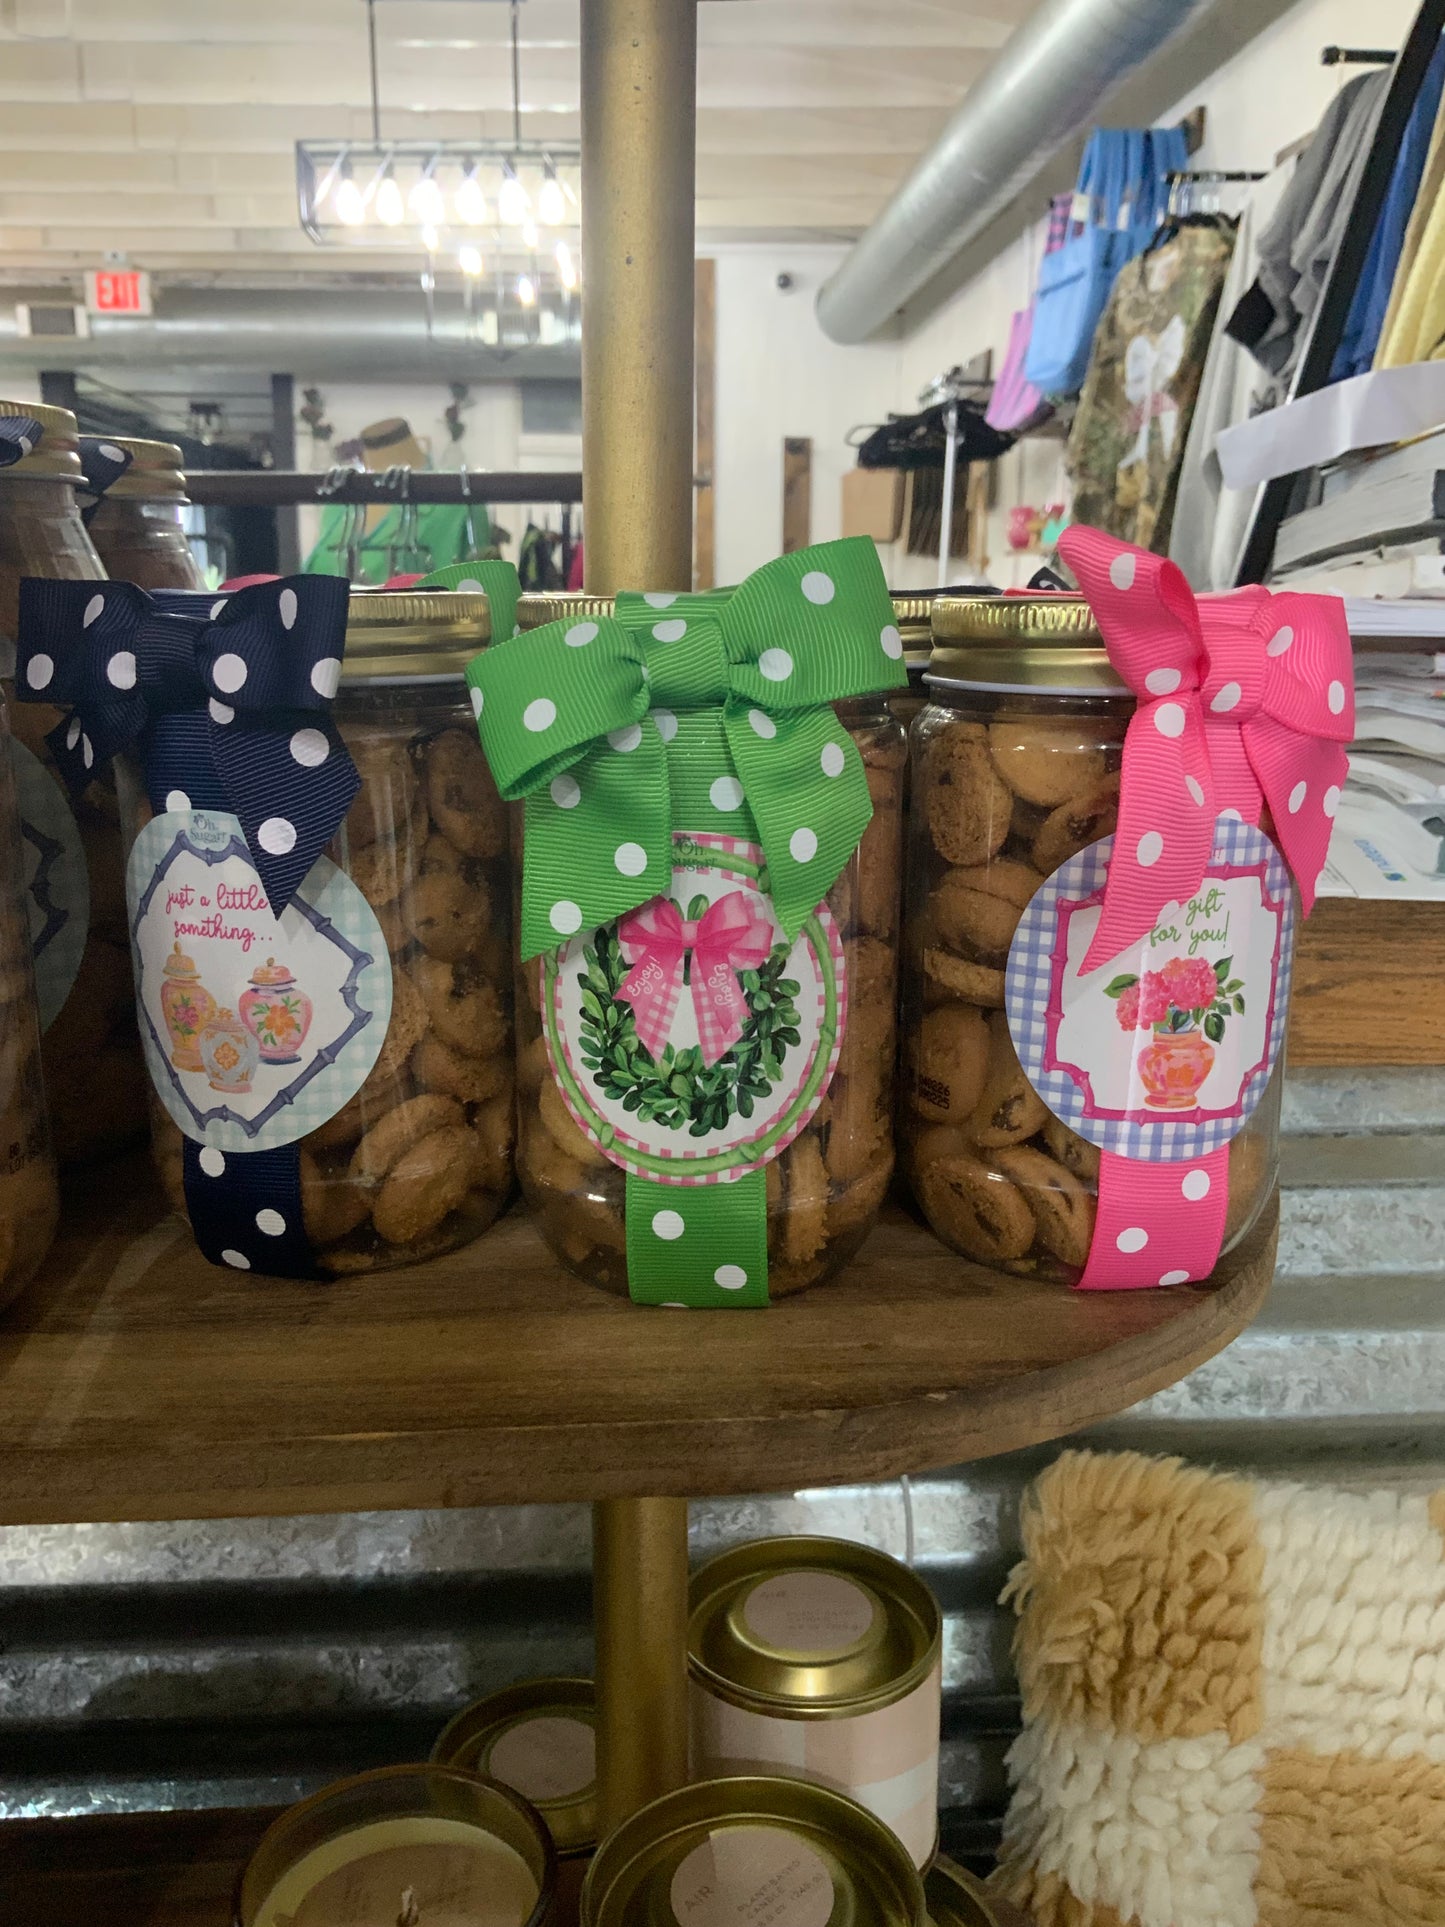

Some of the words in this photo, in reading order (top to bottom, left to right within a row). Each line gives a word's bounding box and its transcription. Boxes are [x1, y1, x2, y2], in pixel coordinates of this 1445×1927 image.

[96, 272, 141, 311] EXIT
[166, 884, 195, 914] just
[200, 896, 211, 907] a
[217, 883, 268, 911] little
[1185, 888, 1226, 927] gift
[1188, 911, 1230, 956] you!
[627, 955, 665, 998] Enjoy!
[708, 963, 740, 1008] Enjoy!
[684, 1886, 714, 1911] AIR
